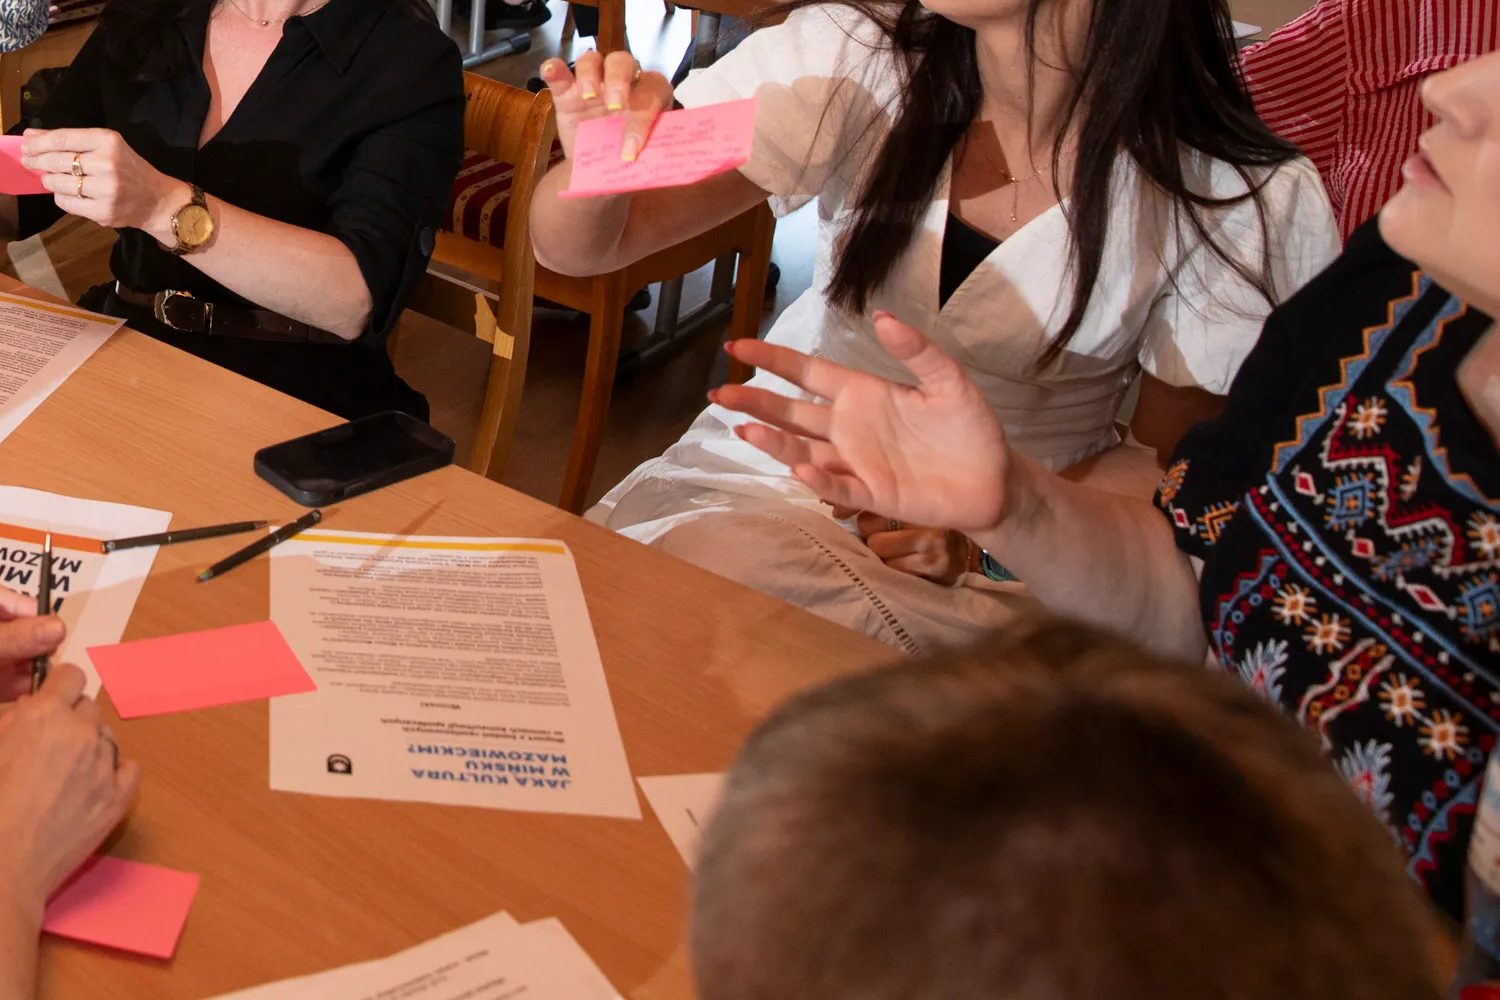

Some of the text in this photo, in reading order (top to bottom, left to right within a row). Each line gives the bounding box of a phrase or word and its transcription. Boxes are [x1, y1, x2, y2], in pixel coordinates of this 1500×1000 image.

[407, 744, 567, 763] MAZOWIECKIM?
[465, 761, 569, 776] W MIŃSKU
[410, 769, 570, 788] JAKA KULTURA
